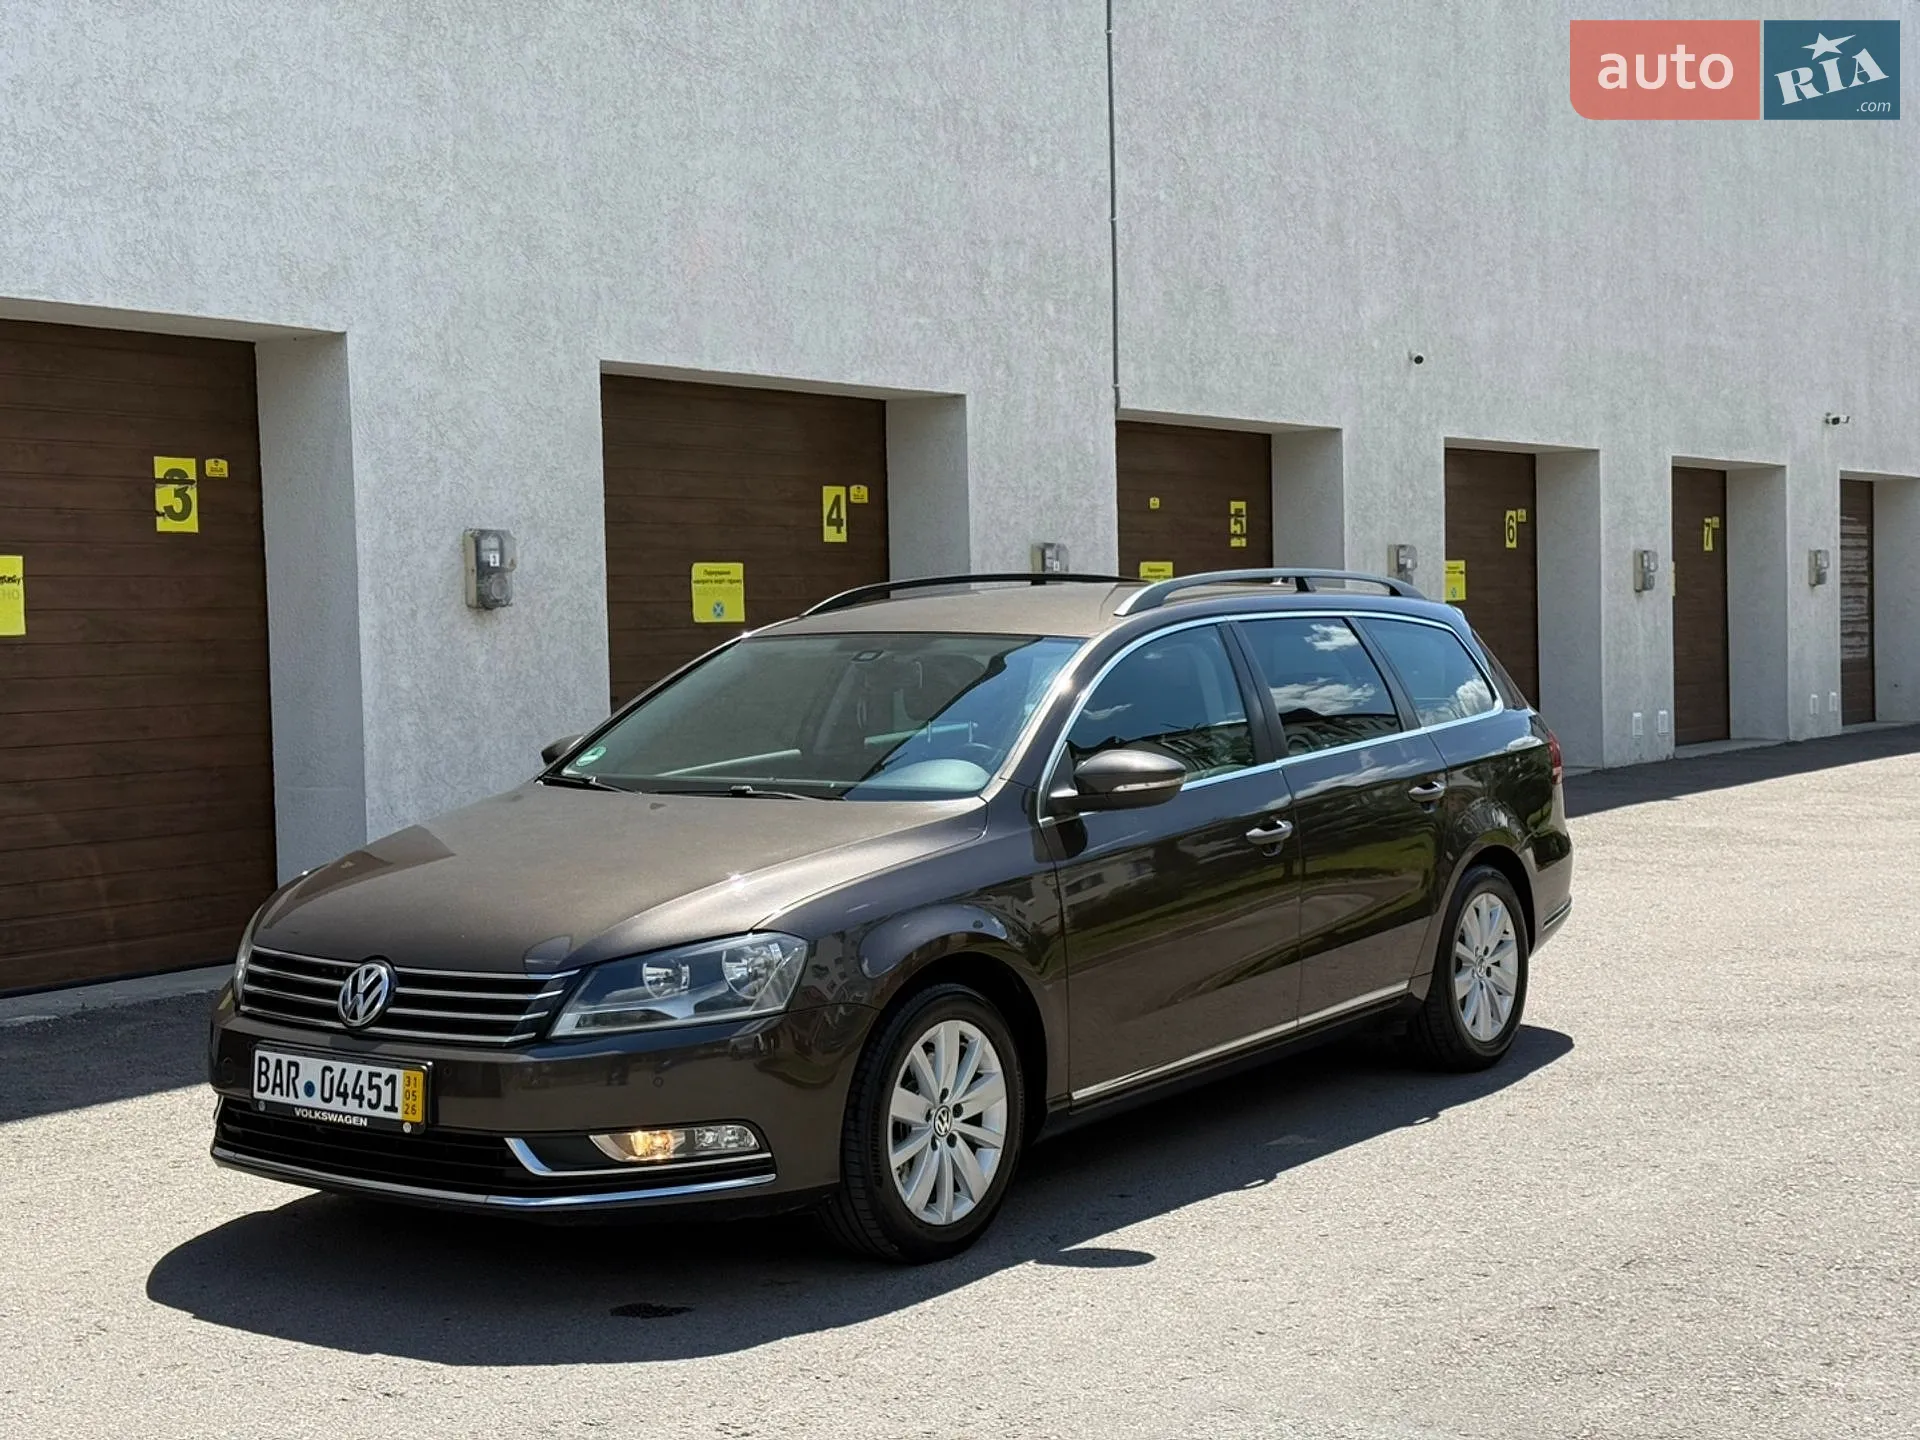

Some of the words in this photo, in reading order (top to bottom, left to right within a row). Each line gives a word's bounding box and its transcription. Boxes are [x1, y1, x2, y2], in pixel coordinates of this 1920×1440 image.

[164, 468, 192, 521] 3
[826, 493, 844, 535] 4
[1507, 515, 1515, 544] 6
[1705, 522, 1711, 547] 7
[256, 1055, 300, 1100] BAR
[320, 1065, 399, 1114] 04451
[404, 1075, 418, 1088] 31
[404, 1089, 417, 1102] 05
[294, 1107, 368, 1127] VOLKSWAGEN
[403, 1103, 417, 1116] 26
